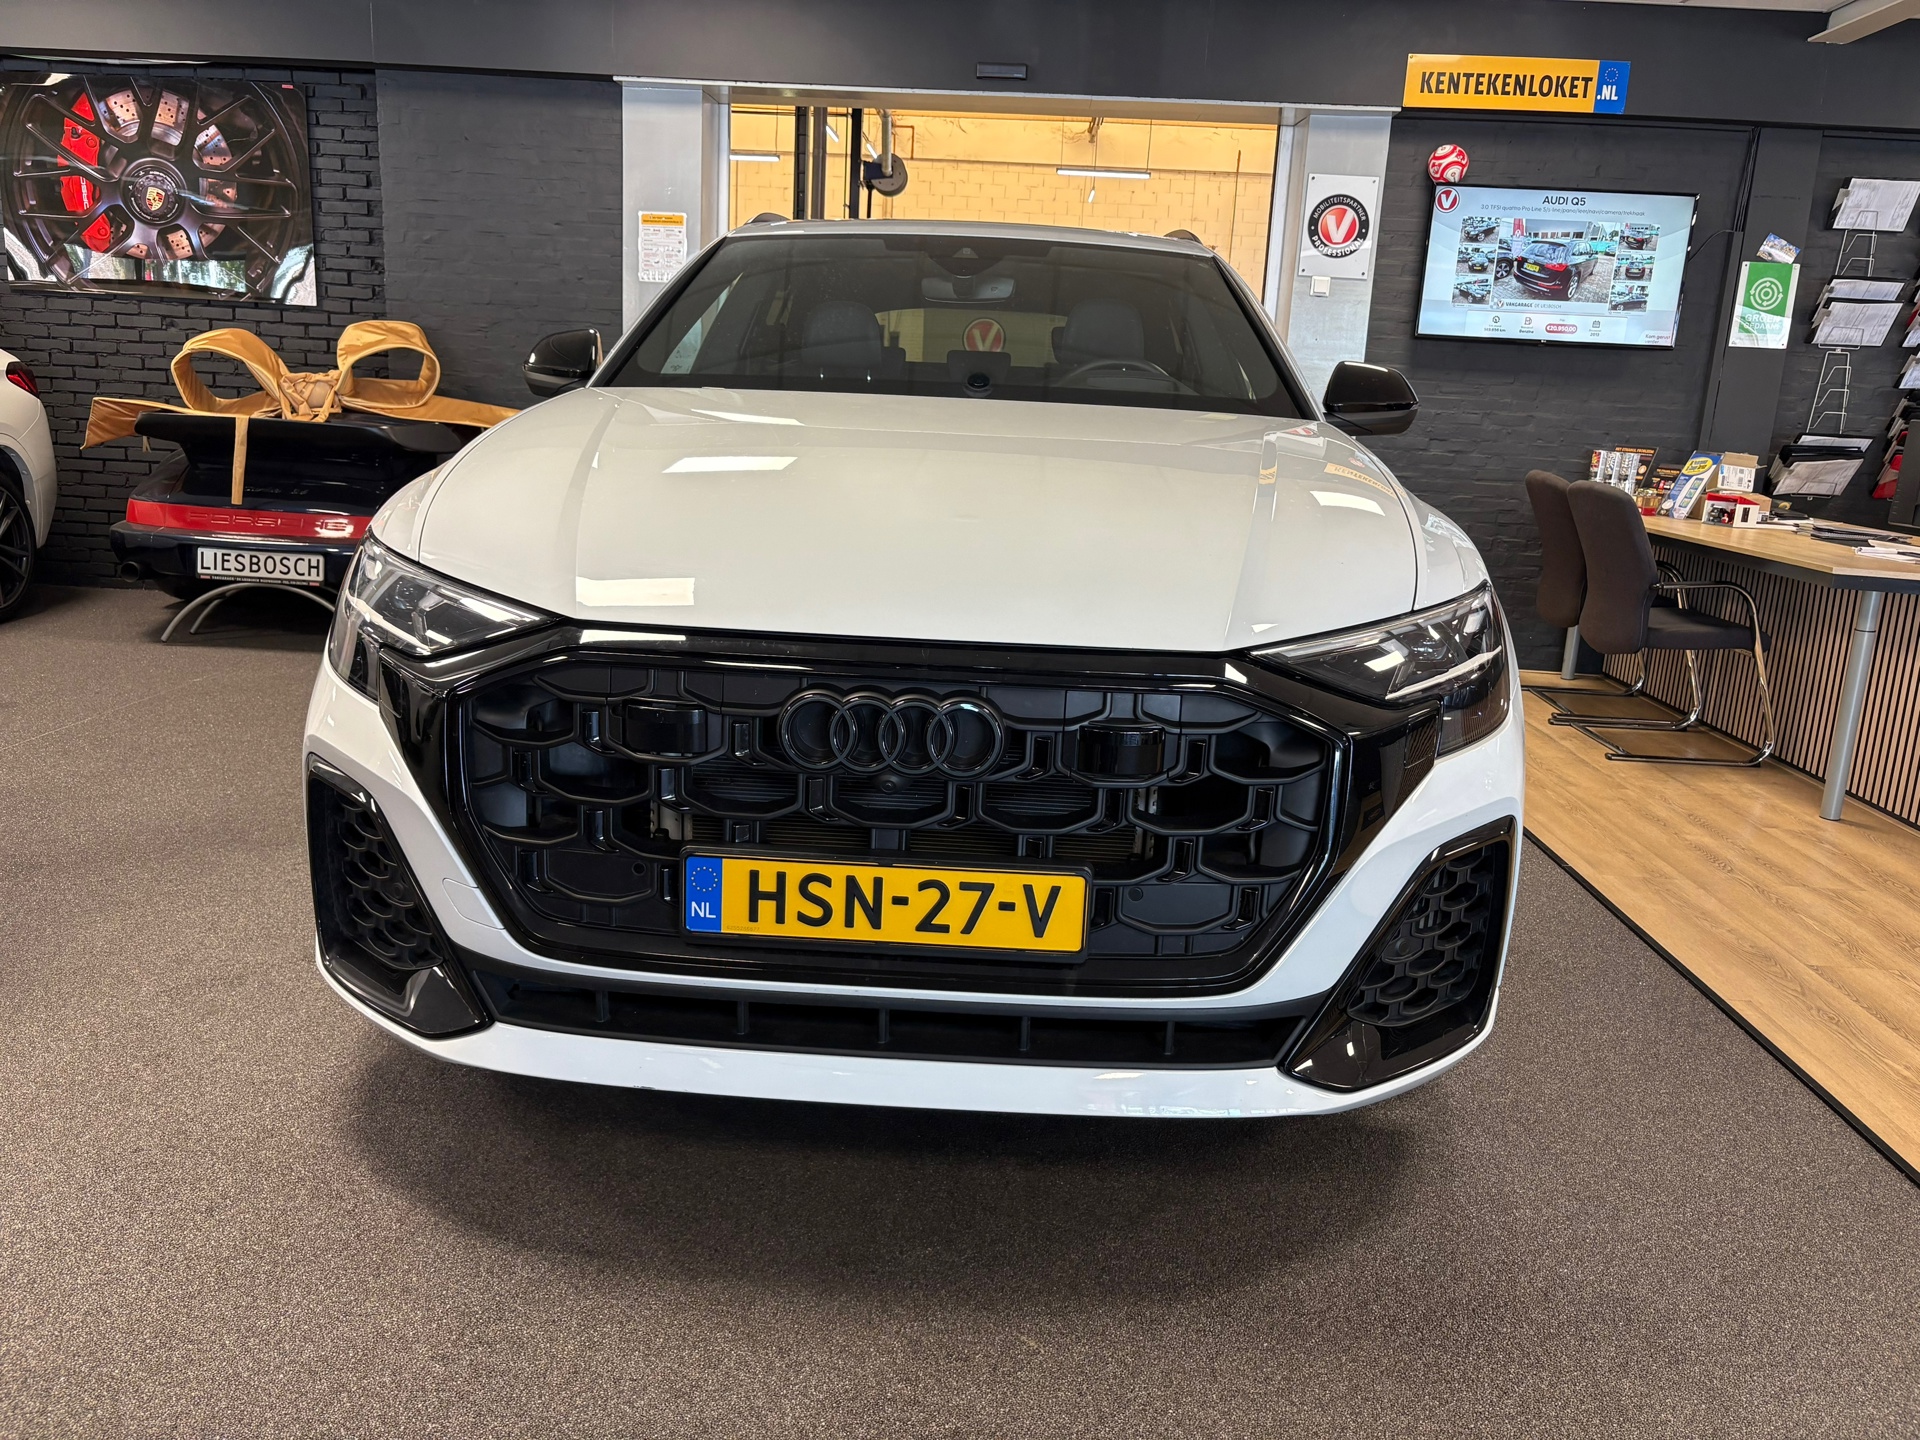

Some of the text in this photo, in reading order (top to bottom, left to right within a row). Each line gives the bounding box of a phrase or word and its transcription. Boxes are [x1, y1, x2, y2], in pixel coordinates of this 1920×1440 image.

[1420, 71, 1593, 99] KENTEKENLOKET
[1313, 196, 1367, 221] MOBILITEITSPARTNER
[1542, 196, 1586, 206] AUDI Q5
[1326, 208, 1355, 243] V
[1312, 235, 1364, 257] PROFESSIONAL
[1745, 314, 1781, 323] GROEN
[972, 323, 999, 352] V
[200, 551, 320, 577] LIESBOSCH
[691, 901, 717, 919] NL
[748, 869, 1062, 939] HSN-27-V
